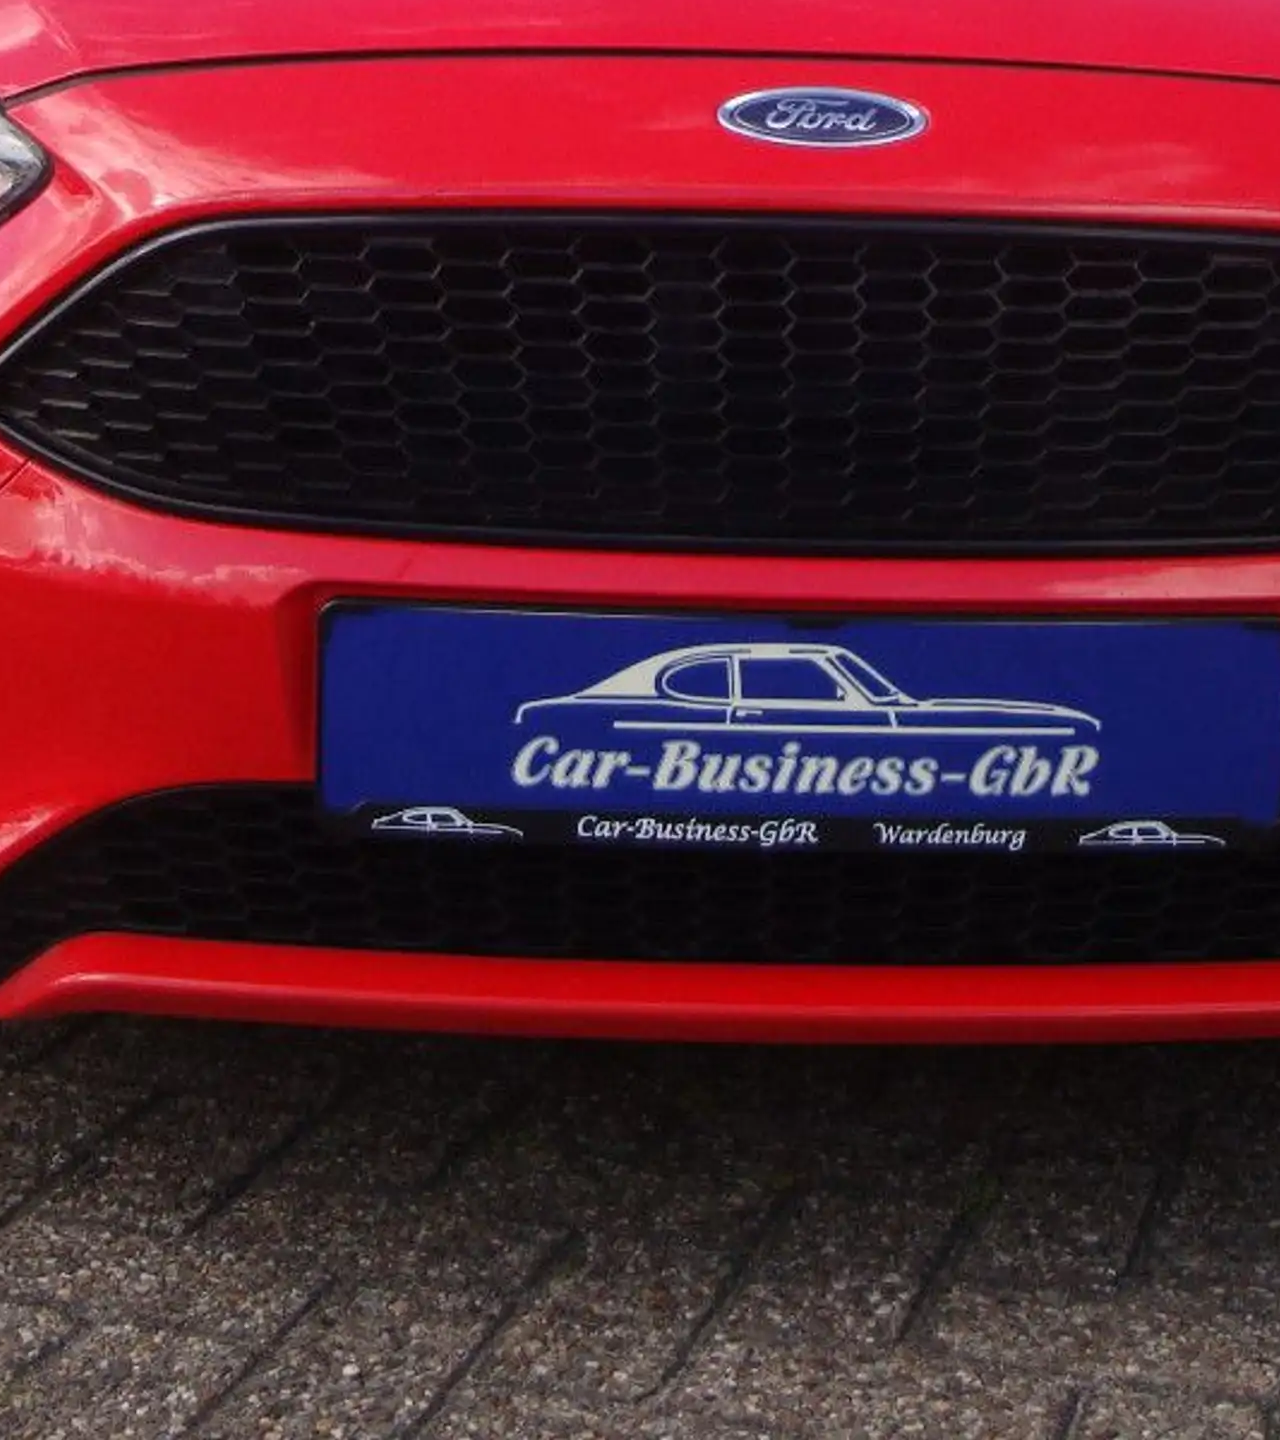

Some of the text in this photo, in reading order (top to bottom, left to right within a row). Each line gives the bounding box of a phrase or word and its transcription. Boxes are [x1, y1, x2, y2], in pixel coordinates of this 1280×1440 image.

[766, 98, 877, 132] Ford
[511, 737, 1100, 797] Car-Business-GbR
[576, 813, 1027, 851] Car-Business-GbR Wardenburg
